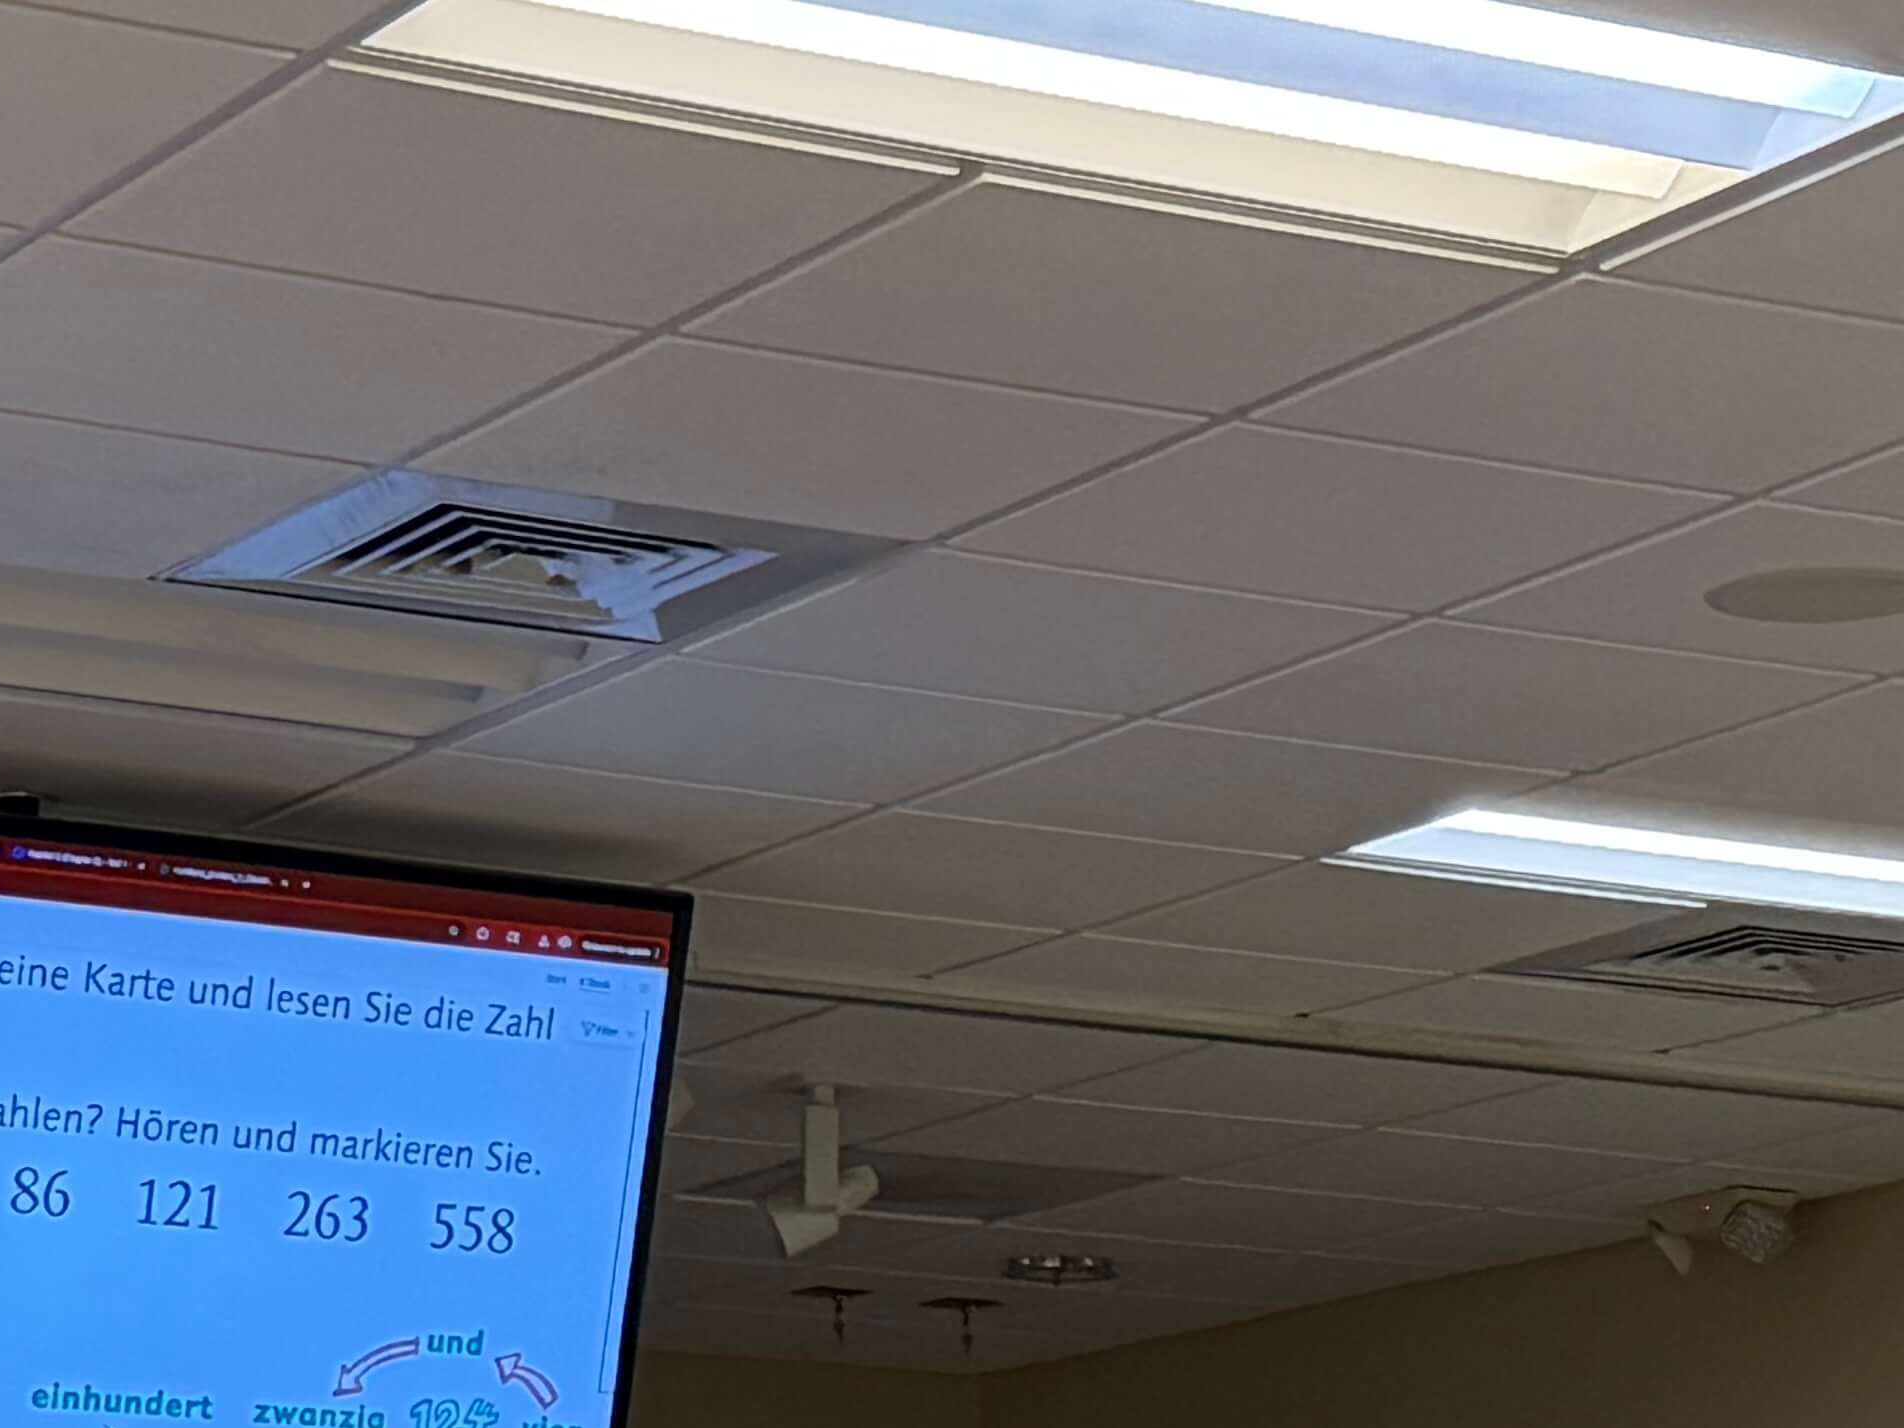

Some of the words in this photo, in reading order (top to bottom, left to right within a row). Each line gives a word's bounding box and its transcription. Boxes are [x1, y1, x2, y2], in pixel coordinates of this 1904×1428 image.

[84, 960, 175, 1002] Karte
[188, 975, 254, 1010] und
[266, 976, 351, 1020] lesen
[363, 991, 413, 1027] Sie
[423, 995, 475, 1033] die
[483, 1003, 555, 1041] Zahl
[115, 1106, 219, 1146] Hören
[232, 1119, 297, 1153] und
[309, 1127, 473, 1169] markieren
[484, 1140, 541, 1176] Sie.
[9, 1166, 71, 1218] 86
[136, 1178, 219, 1231] 121
[282, 1190, 369, 1243] 263
[429, 1202, 515, 1255] 558
[426, 1328, 485, 1356] und
[31, 1381, 213, 1420] einhundert
